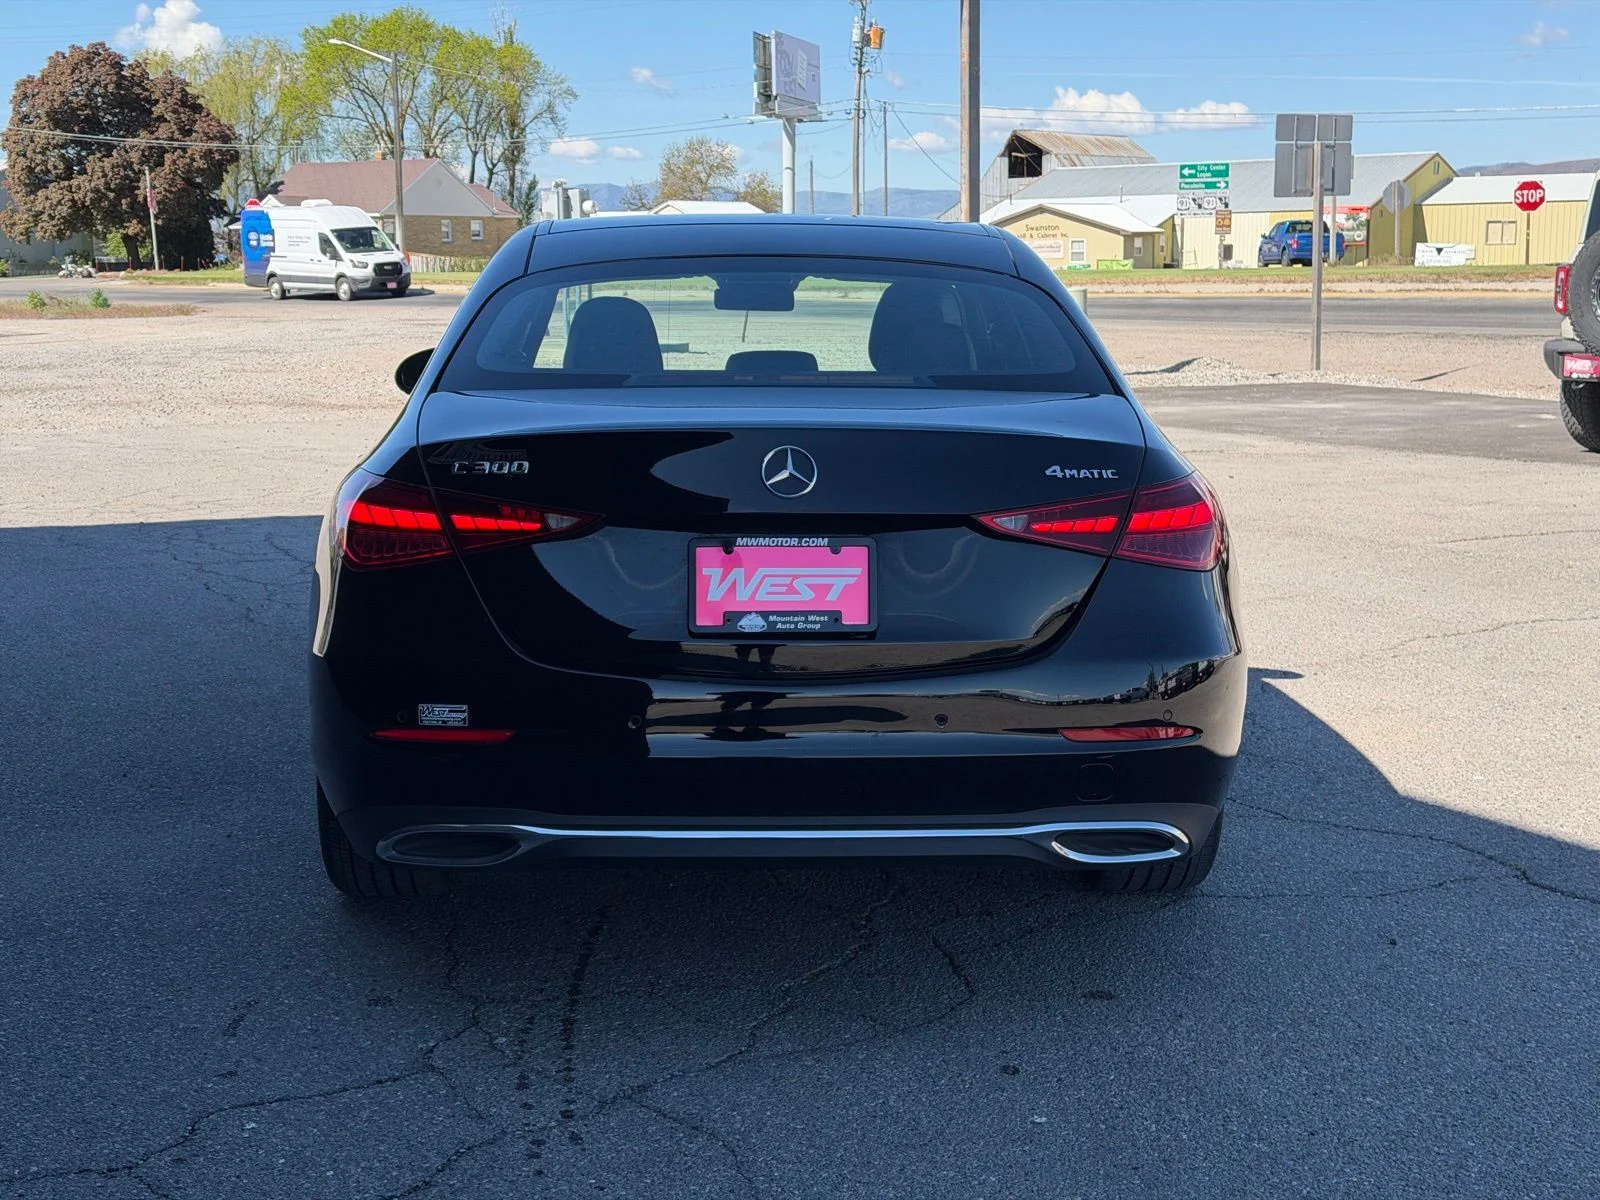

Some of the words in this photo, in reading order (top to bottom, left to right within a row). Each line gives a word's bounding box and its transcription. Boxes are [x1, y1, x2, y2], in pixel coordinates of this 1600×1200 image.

[1515, 189, 1544, 204] STOP
[1025, 224, 1060, 232] Swainston
[1044, 465, 1119, 479] 4MATIC
[736, 537, 829, 547] MWMOTOR.COM
[702, 567, 863, 602] WEST
[768, 614, 806, 622] Mountain
[807, 614, 829, 622] West
[797, 622, 821, 630] Group
